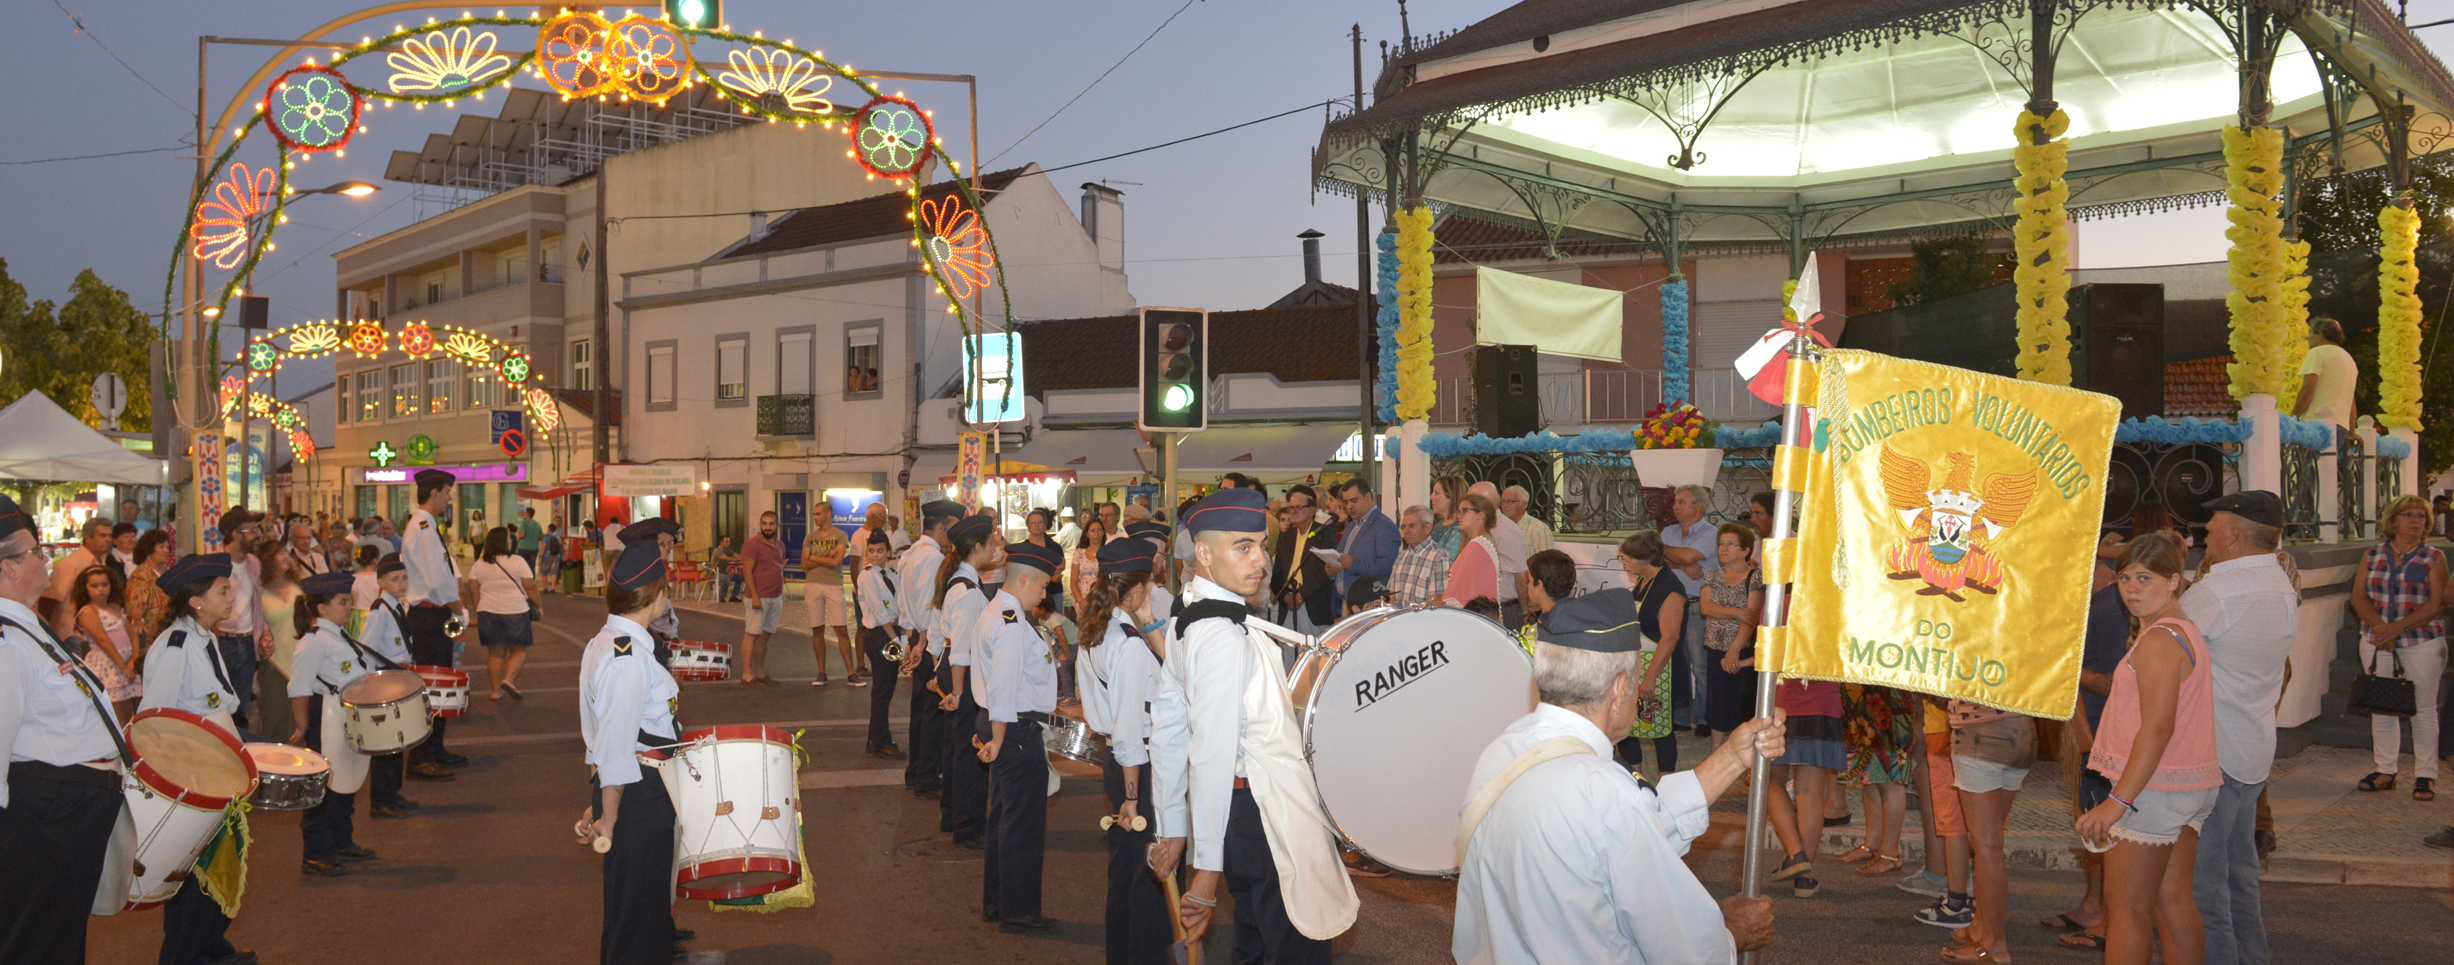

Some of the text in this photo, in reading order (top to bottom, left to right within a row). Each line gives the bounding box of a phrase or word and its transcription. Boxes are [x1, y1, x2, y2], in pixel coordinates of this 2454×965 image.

[1973, 390, 2091, 500] VOLUNTÁRIOS
[1917, 619, 1952, 640] DO
[1355, 640, 1450, 706] RANGER
[1849, 637, 2006, 687] MONTIJO
